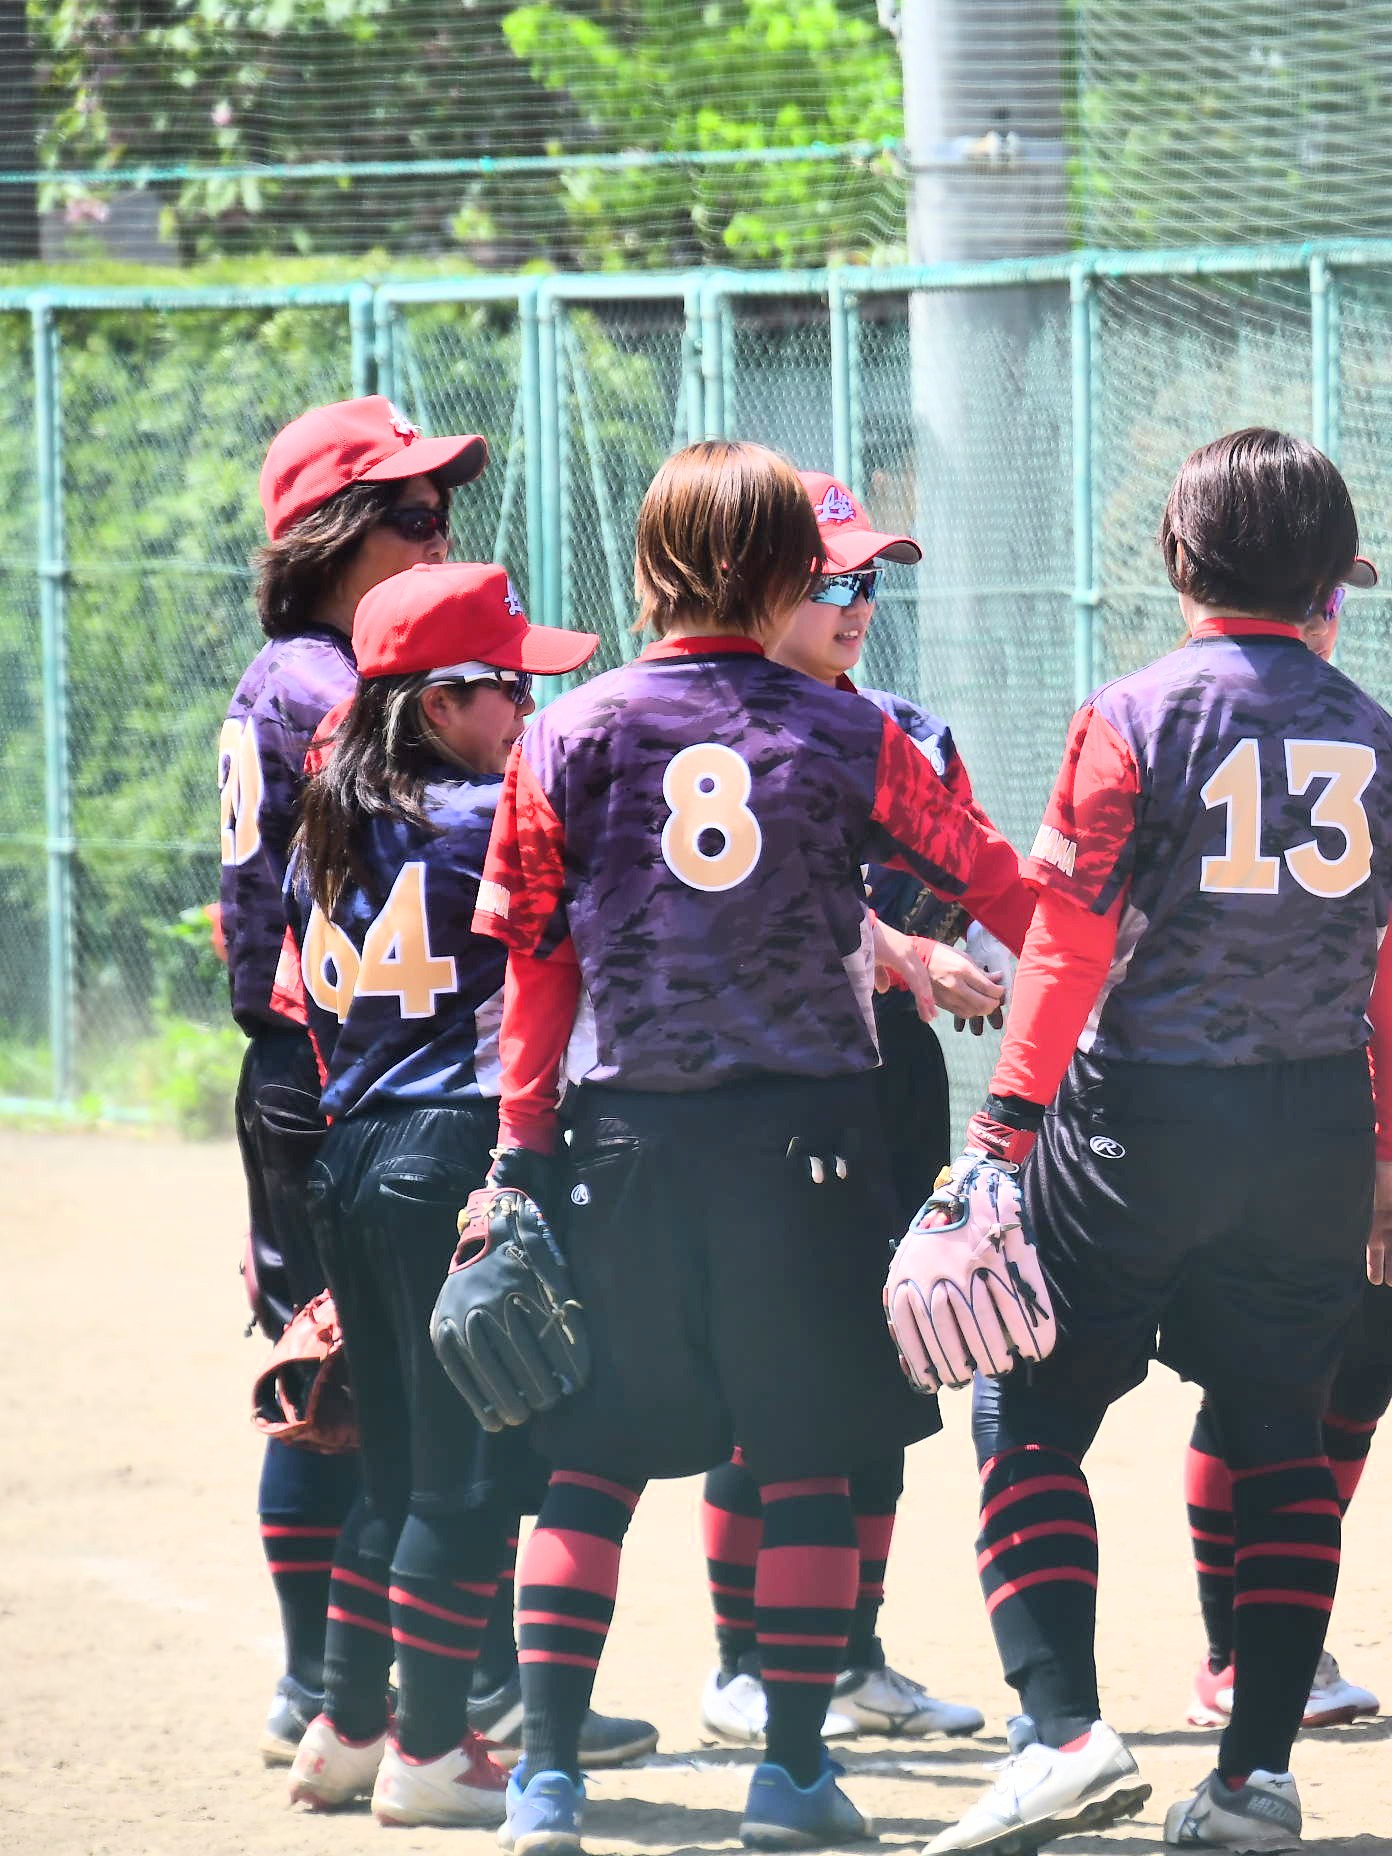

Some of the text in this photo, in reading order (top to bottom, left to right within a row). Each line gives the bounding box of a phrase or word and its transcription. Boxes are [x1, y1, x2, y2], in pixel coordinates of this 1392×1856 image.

[661, 743, 762, 891] 8
[1200, 738, 1377, 897] 13
[301, 861, 458, 1024] 64
